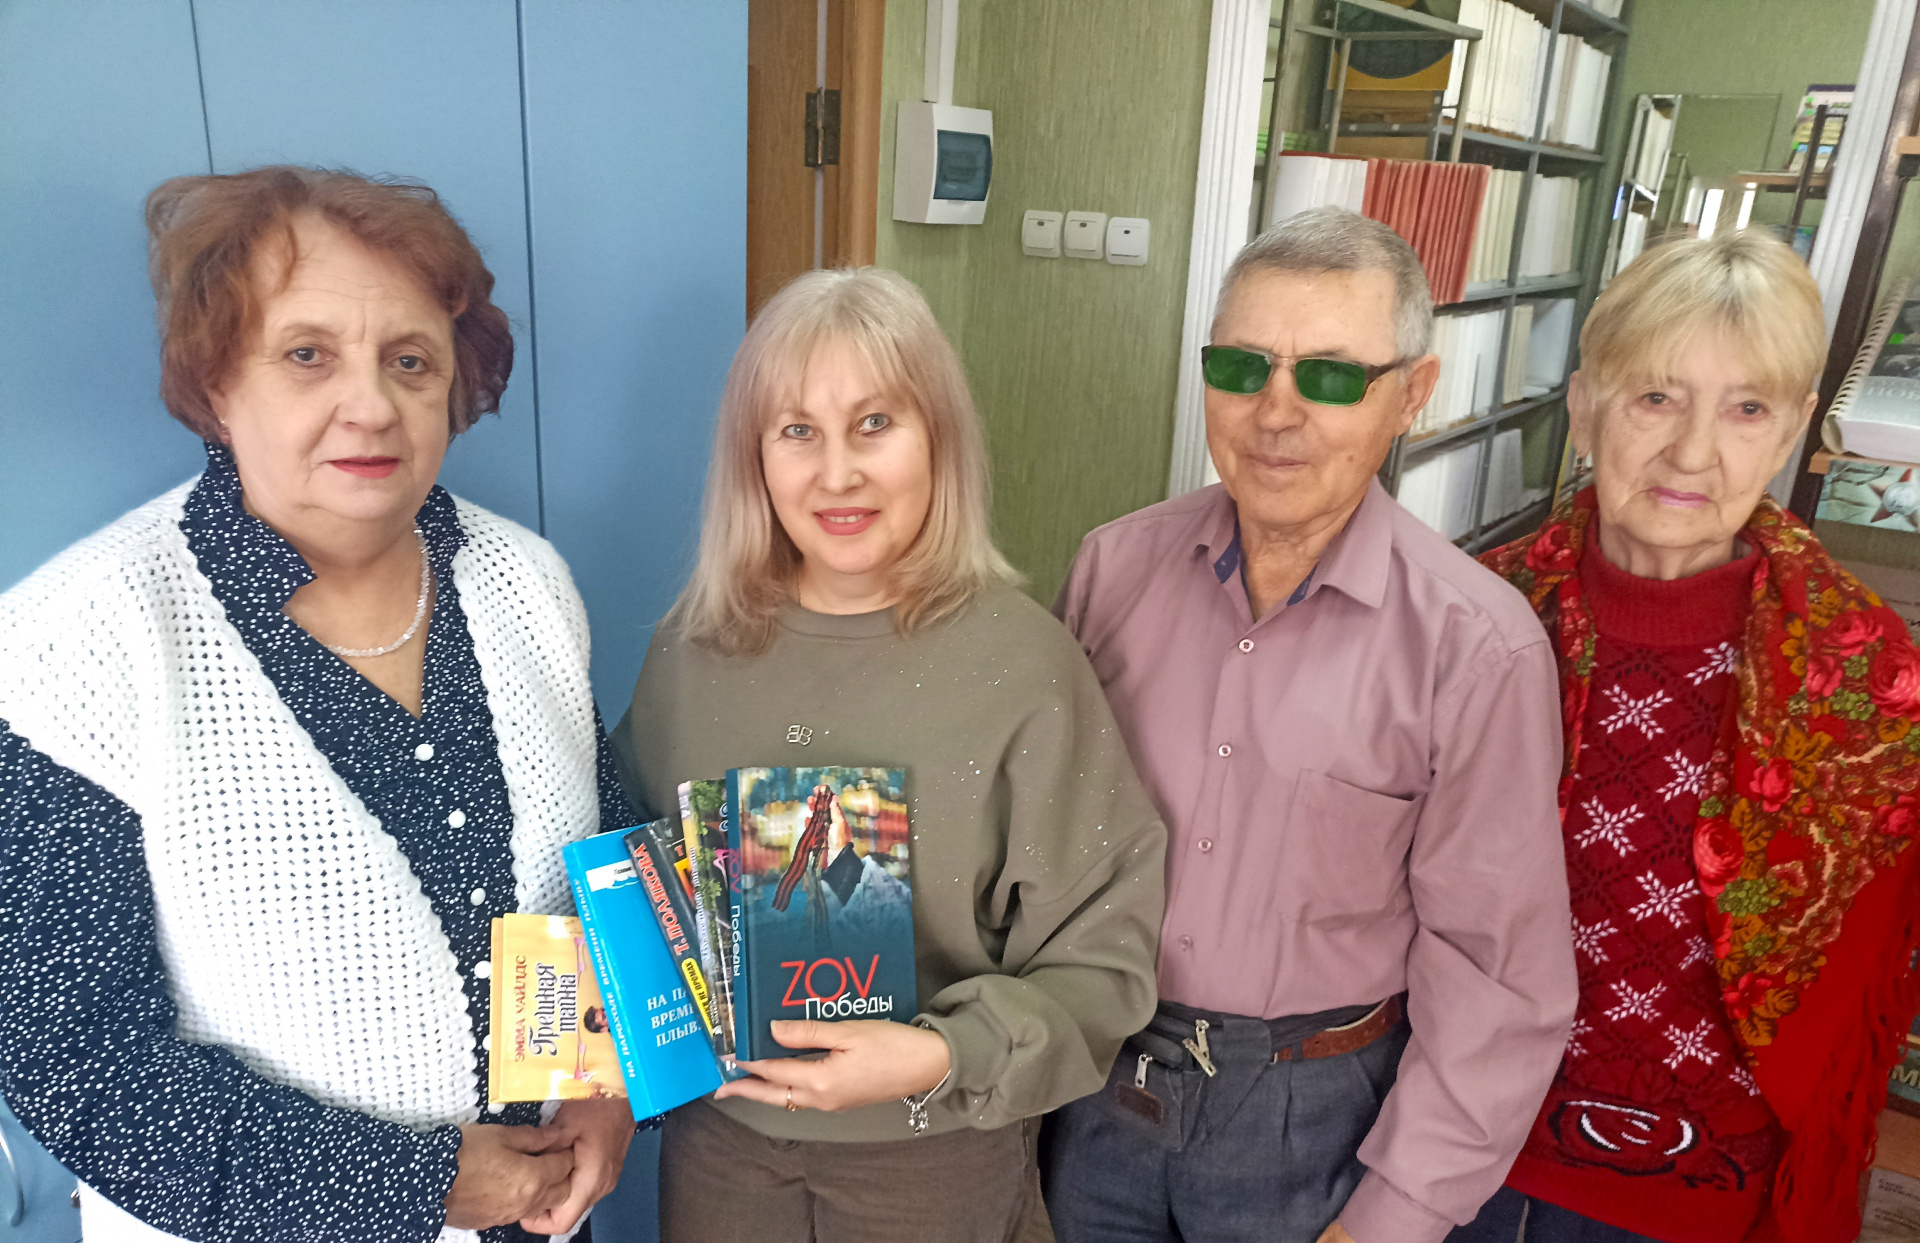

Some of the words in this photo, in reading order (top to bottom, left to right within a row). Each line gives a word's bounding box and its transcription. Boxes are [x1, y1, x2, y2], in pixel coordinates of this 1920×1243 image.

[633, 842, 684, 941] ПОЛЯКОВА
[729, 848, 742, 894] ZOV
[731, 905, 742, 977] Победы
[557, 974, 578, 1033] тайна
[647, 994, 668, 1011] НА
[780, 954, 880, 1007] ZOV
[528, 962, 560, 1057] Грешная
[805, 992, 893, 1020] Победы
[514, 1018, 526, 1063] ЭММА
[656, 1021, 701, 1047] ПЛЫВ
